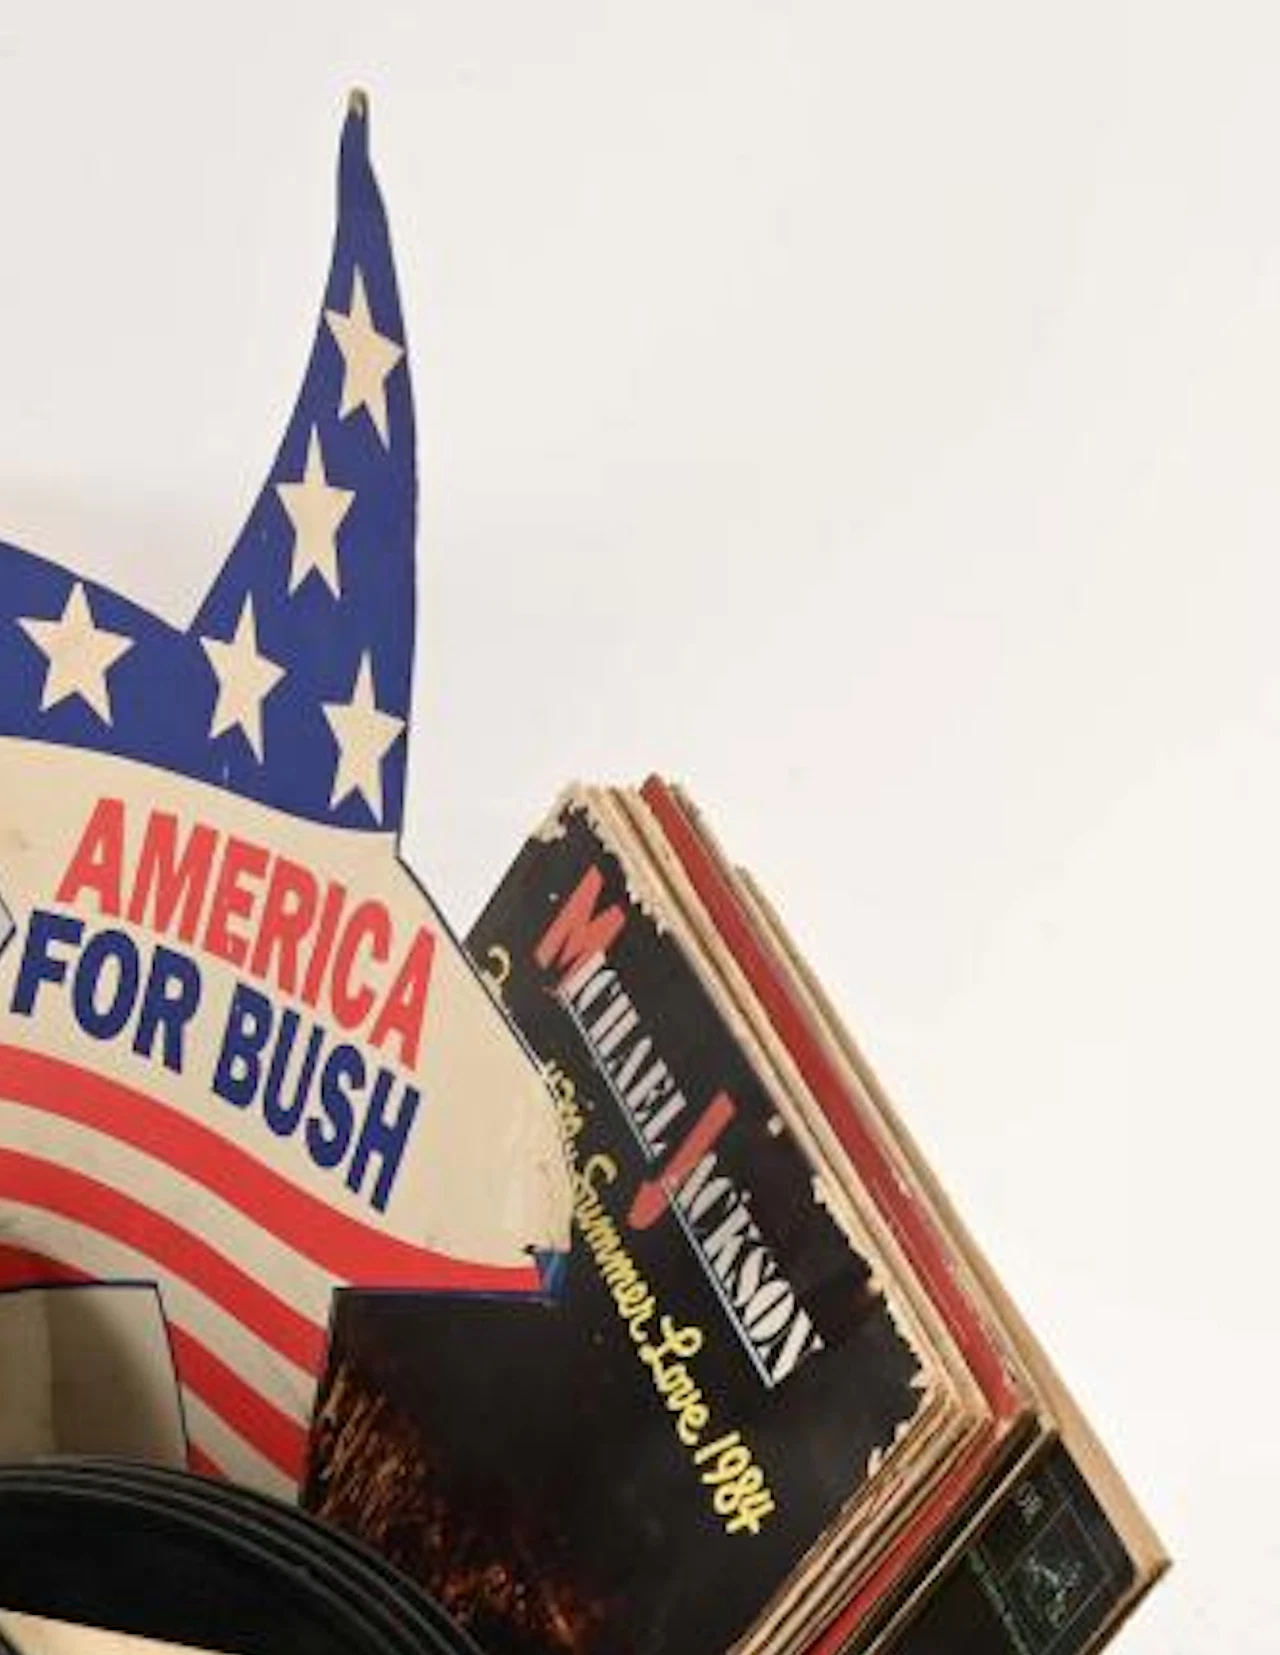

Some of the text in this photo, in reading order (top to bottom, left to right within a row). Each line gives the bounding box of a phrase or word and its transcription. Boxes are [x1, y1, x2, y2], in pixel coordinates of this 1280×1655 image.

[10, 909, 202, 1075] FOR
[213, 983, 421, 1216] BUSH
[54, 798, 436, 1071] AMERICA
[533, 864, 825, 1388] MICHAEL JACKSON
[572, 1153, 775, 1535] Summer Love 1984
